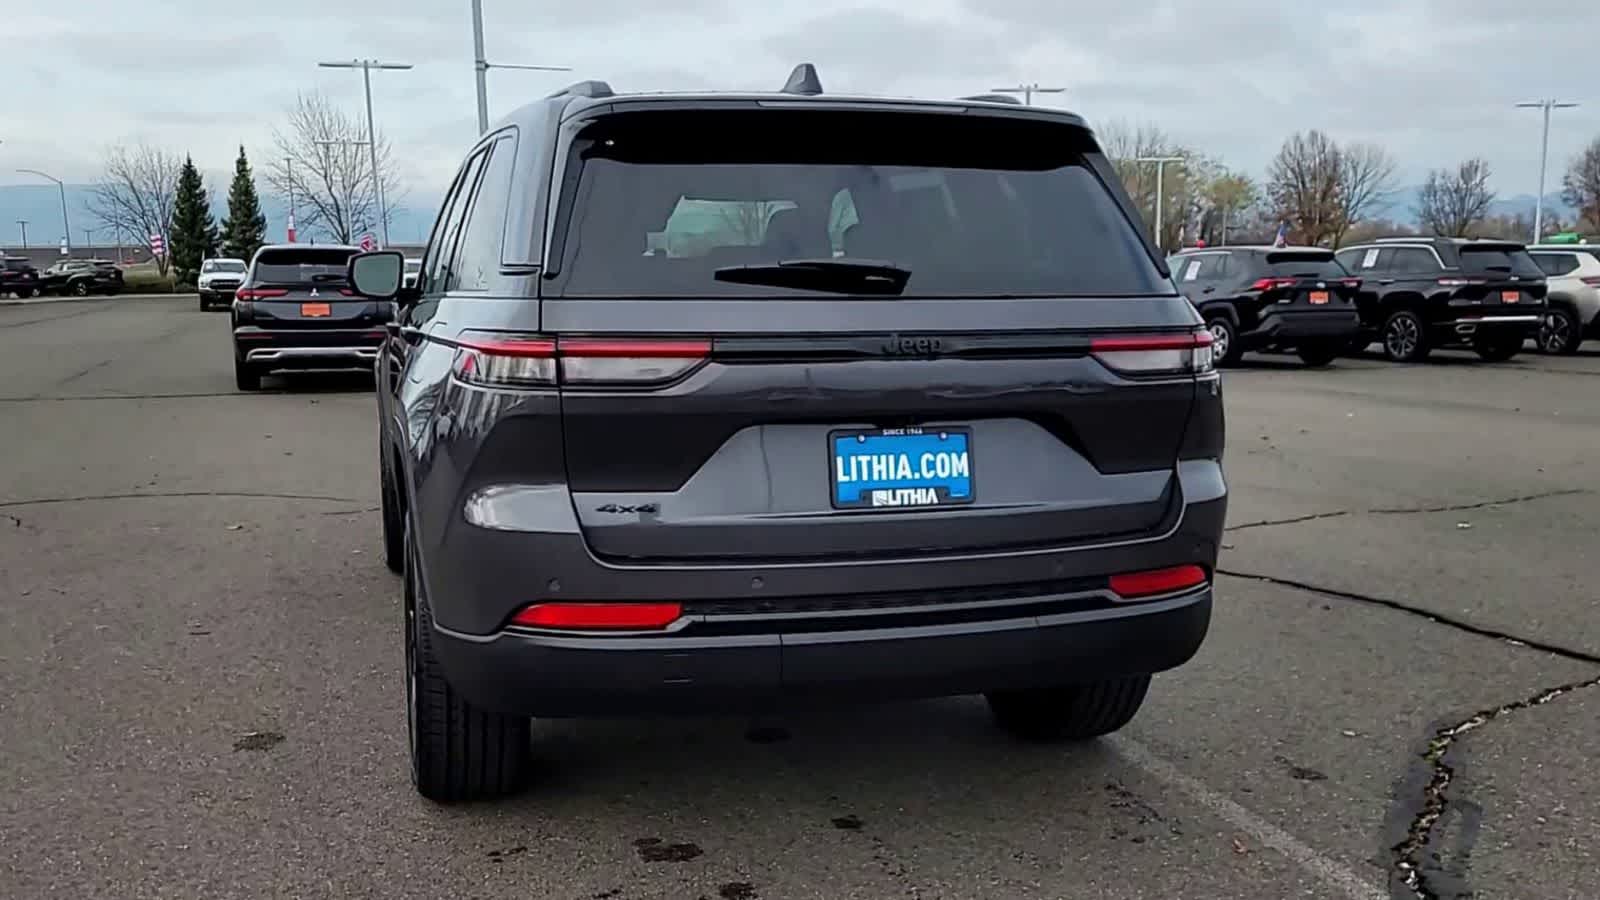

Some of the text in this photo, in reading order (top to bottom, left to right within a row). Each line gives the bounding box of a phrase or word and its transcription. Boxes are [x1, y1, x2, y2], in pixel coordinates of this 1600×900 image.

[881, 333, 943, 355] Jeep
[883, 428, 904, 436] SINCE
[836, 452, 969, 483] LITHIA.COM
[887, 488, 939, 505] LITHIA
